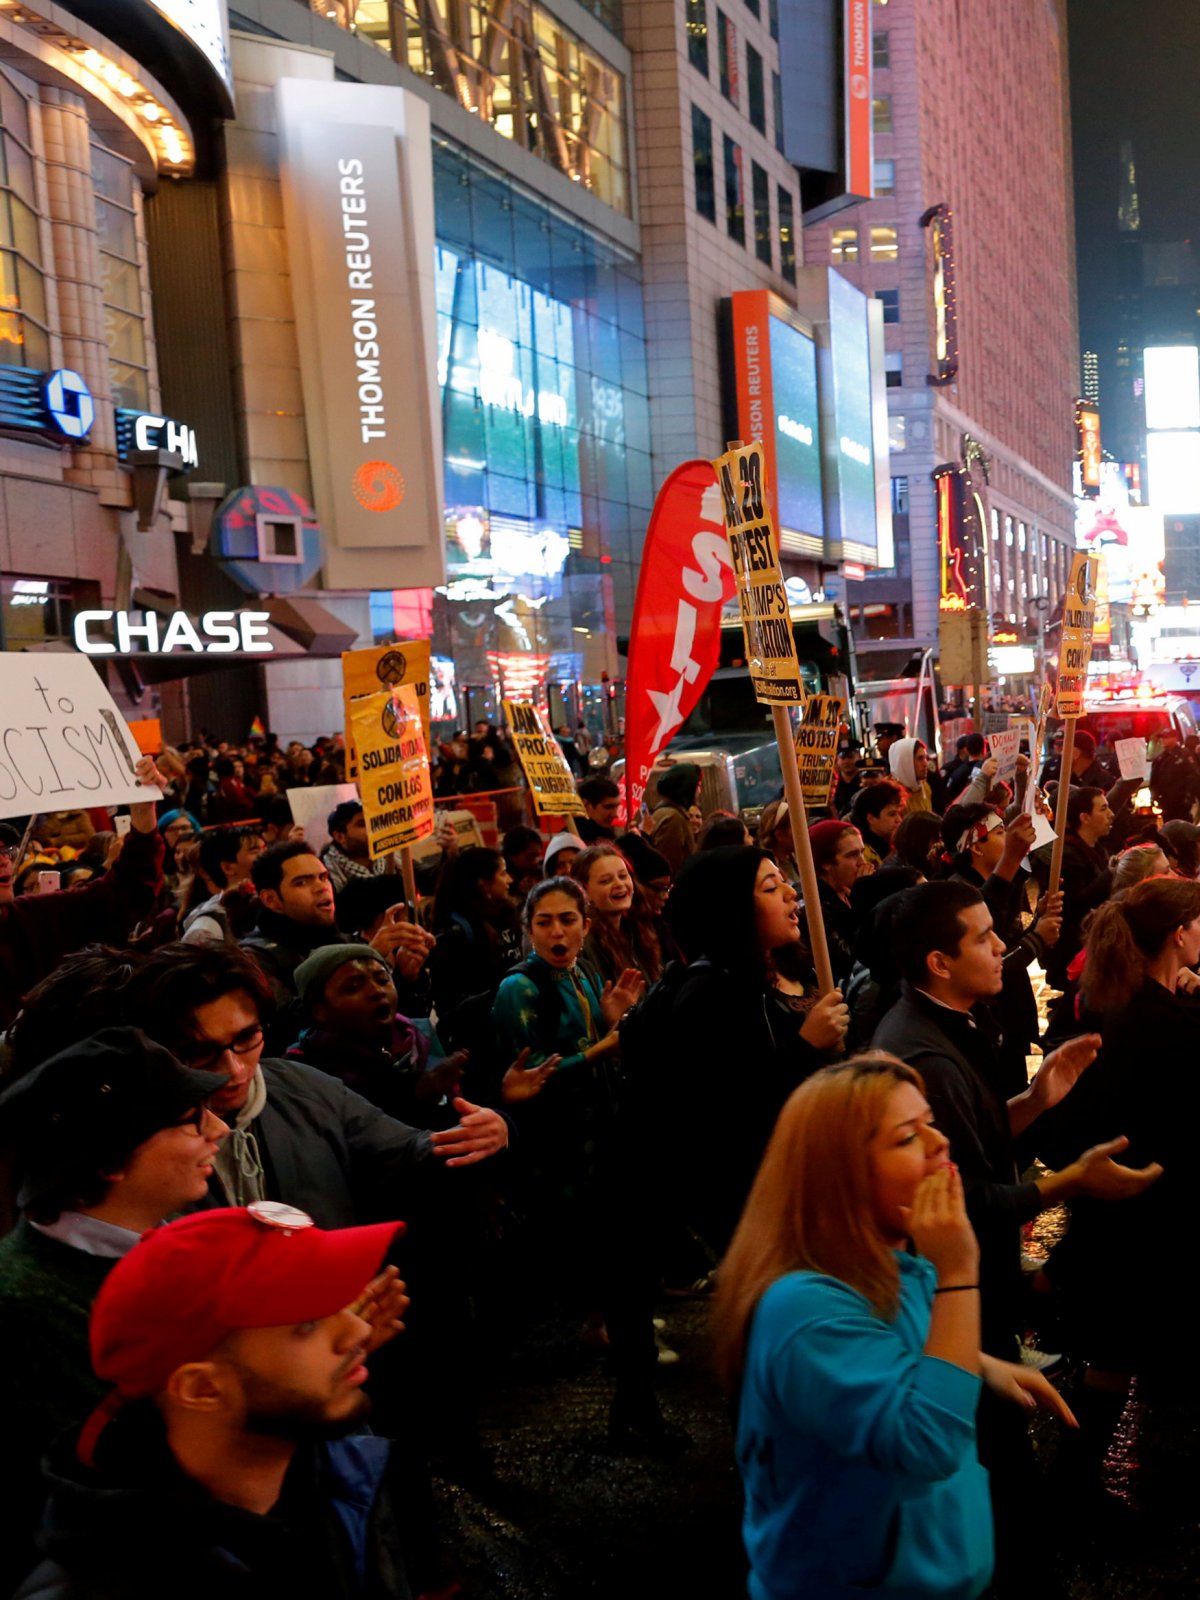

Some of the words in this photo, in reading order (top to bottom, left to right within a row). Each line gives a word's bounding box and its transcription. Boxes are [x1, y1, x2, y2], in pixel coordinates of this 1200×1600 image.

[853, 2, 865, 66] THOMSON
[338, 158, 374, 290] REUTERS
[351, 299, 387, 444] THOMSON
[746, 325, 762, 395] REUTERS
[750, 399, 764, 444] MSON
[739, 452, 764, 522] 20
[73, 610, 274, 654] CHASE
[33, 676, 75, 714] to
[0, 708, 142, 801] CISM!
[377, 784, 405, 807] CON
[403, 774, 423, 799] LOS
